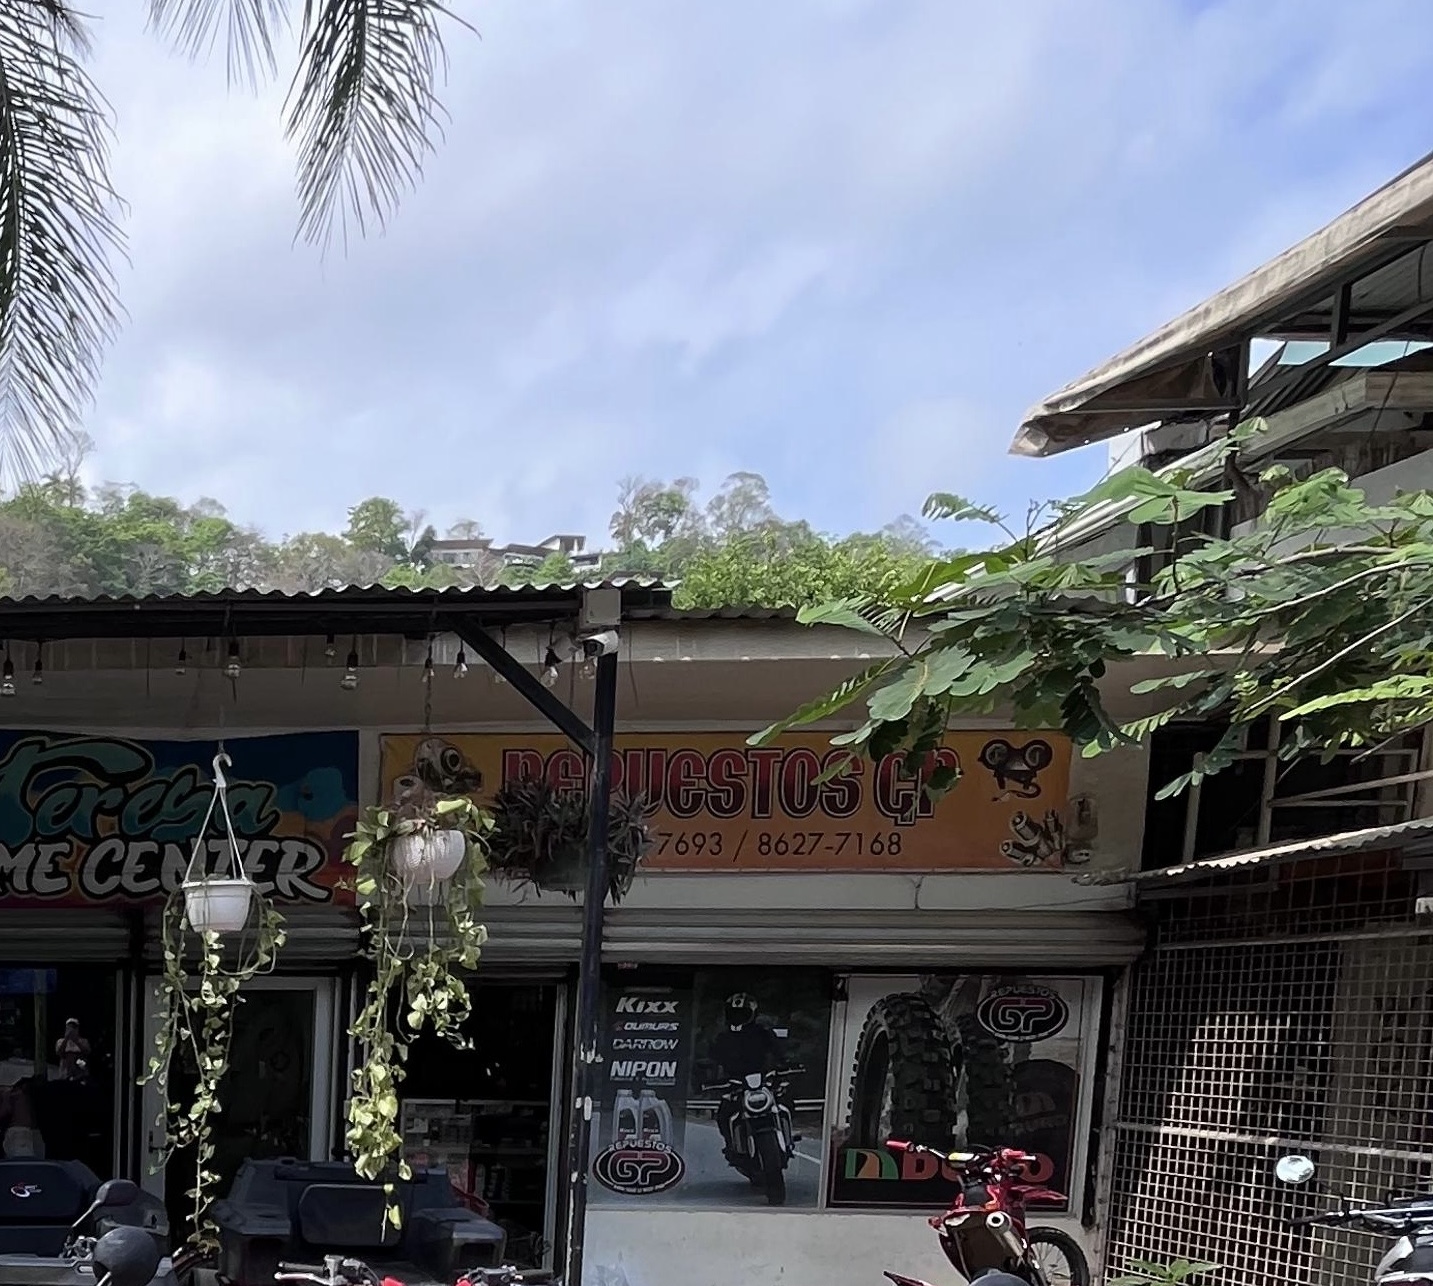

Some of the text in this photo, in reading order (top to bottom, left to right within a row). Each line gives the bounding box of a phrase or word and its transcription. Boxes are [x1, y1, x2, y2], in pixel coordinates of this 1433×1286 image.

[757, 831, 903, 859] 8627-7168
[83, 837, 331, 900] CENTER
[615, 996, 679, 1014] Kixx
[613, 1038, 680, 1051] DARROW
[610, 1060, 677, 1077] NIPON
[607, 1138, 674, 1155] REPUESTOS
[608, 1149, 672, 1186] GP
